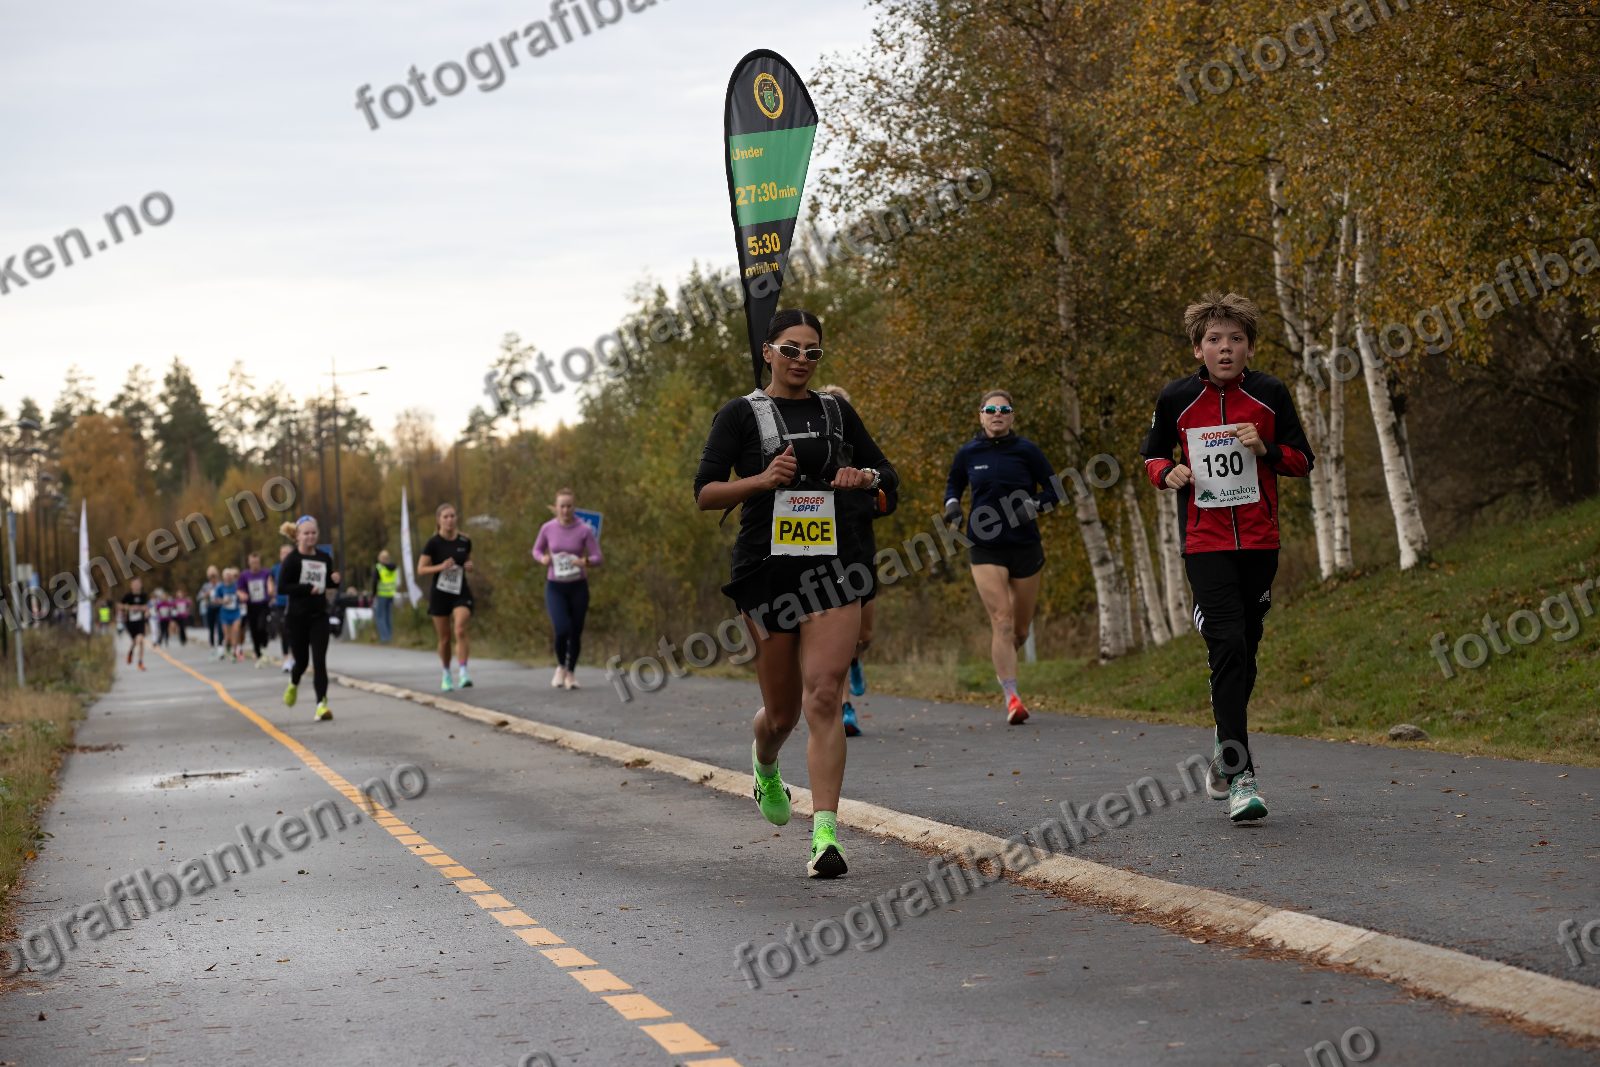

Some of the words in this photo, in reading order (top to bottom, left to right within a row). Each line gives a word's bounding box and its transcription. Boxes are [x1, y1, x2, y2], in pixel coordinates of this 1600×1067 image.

[732, 147, 764, 161] Under
[747, 232, 780, 256] 5:30
[1201, 431, 1232, 440] NORG
[1205, 438, 1235, 448] LØPET
[1203, 451, 1243, 478] 130
[1220, 486, 1257, 497] Aurskog
[780, 521, 831, 541] PACE
